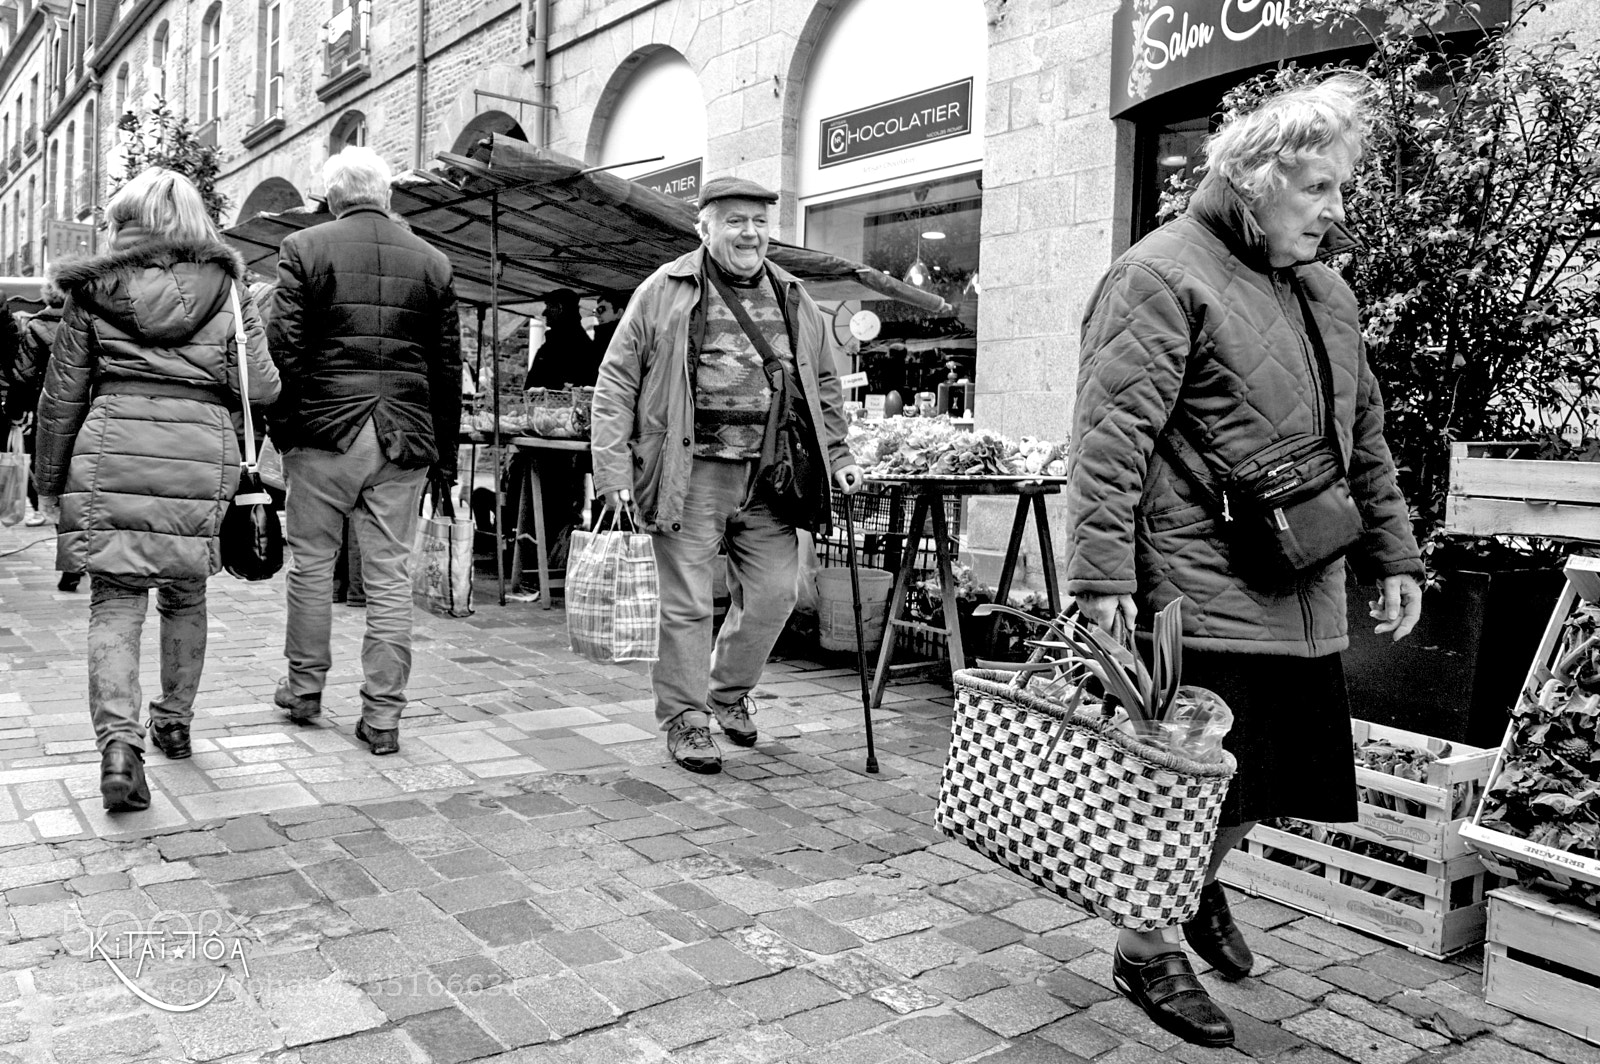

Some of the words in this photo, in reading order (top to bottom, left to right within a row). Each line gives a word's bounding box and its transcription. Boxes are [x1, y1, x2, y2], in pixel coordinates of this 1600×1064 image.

[1143, 5, 1214, 70] Salon
[830, 101, 960, 153] CHOCOLATIER
[1523, 845, 1585, 869] BRETAGNE
